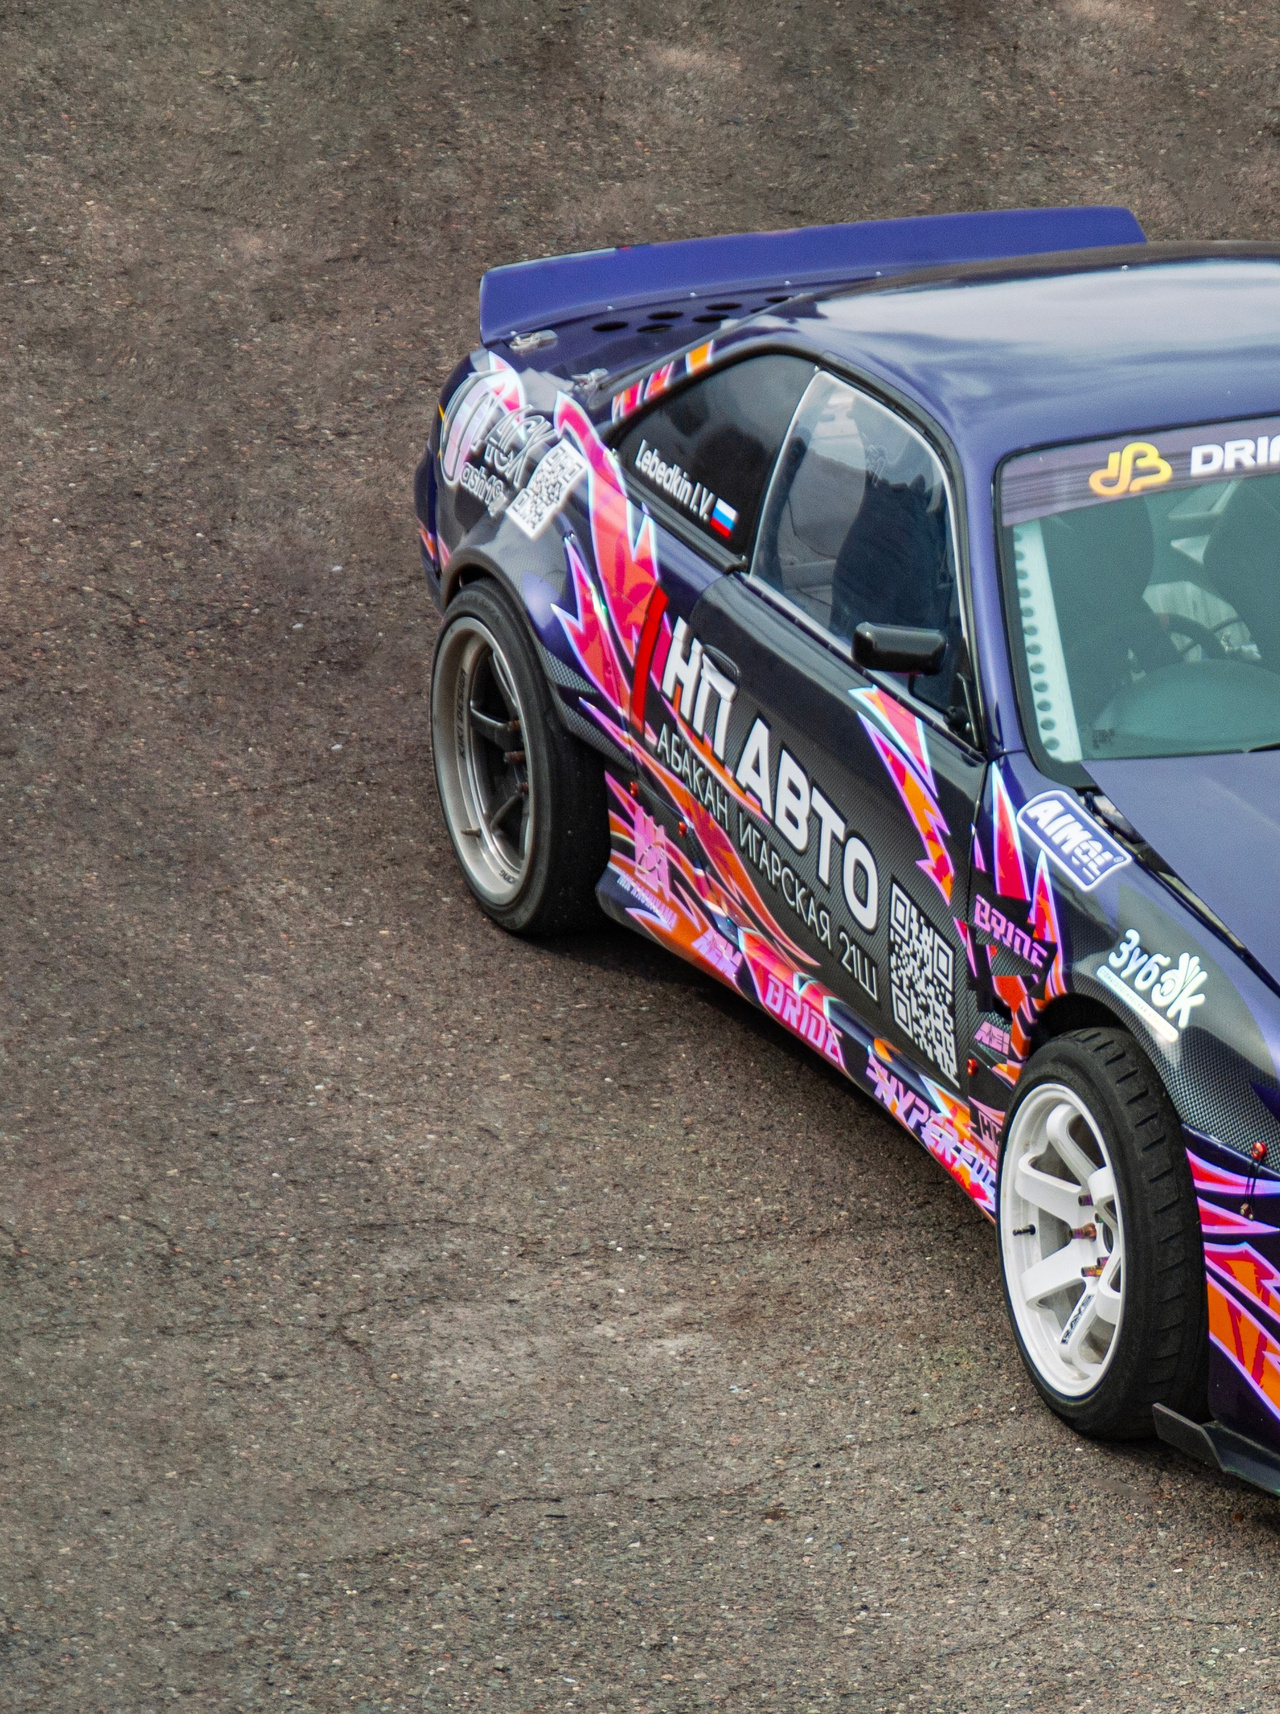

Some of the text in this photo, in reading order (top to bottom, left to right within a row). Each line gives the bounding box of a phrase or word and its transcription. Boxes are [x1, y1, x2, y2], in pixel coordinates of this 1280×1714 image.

[635, 438, 715, 521] Lebedkin I.V.
[657, 722, 878, 1001] АБАКАН ИГАРСКАЯ 21Ш
[661, 615, 879, 932] НП АВТО
[765, 973, 842, 1063] BRIDE
